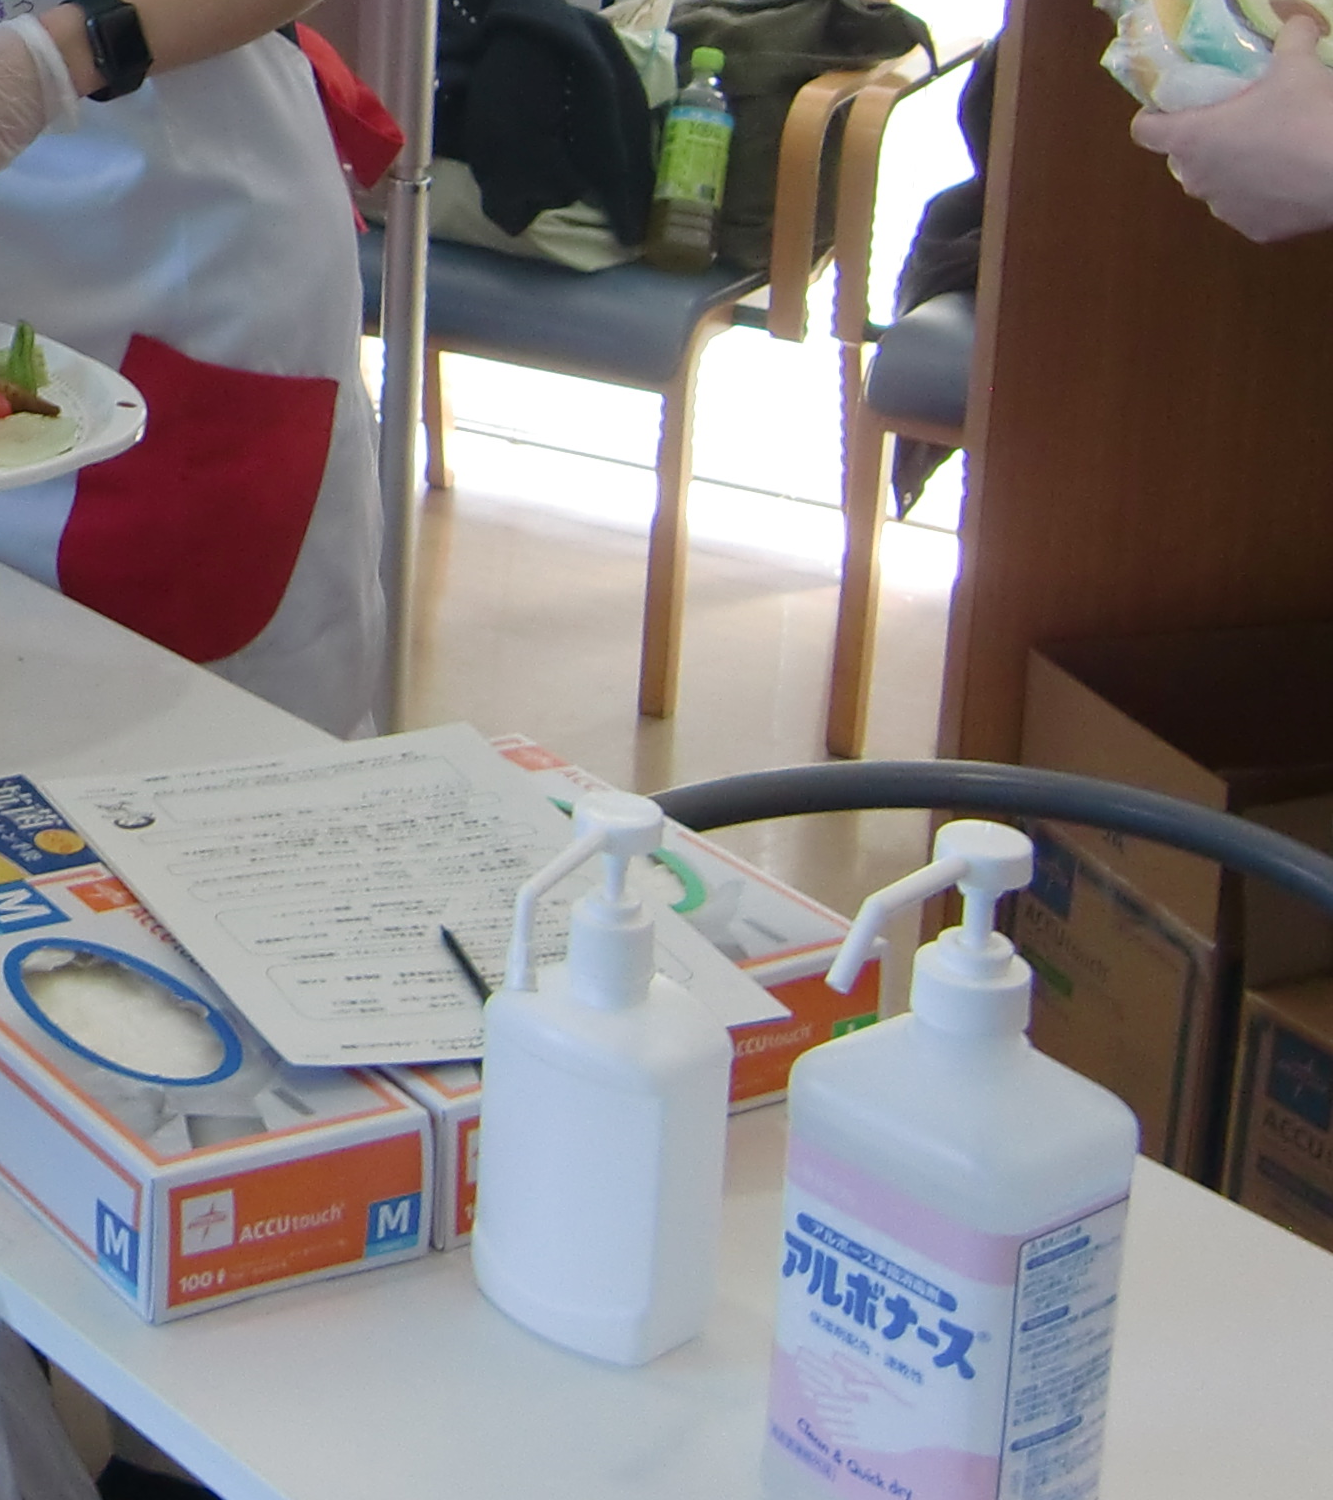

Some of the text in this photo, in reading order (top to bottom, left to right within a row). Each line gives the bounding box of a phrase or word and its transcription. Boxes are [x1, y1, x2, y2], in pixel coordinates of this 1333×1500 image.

[734, 1024, 812, 1057] CCUtouch
[376, 1199, 412, 1240] M
[102, 1213, 131, 1274] M
[781, 1230, 976, 1380] アルボナース
[832, 1449, 844, 1466] &
[846, 1458, 887, 1491] Quick
